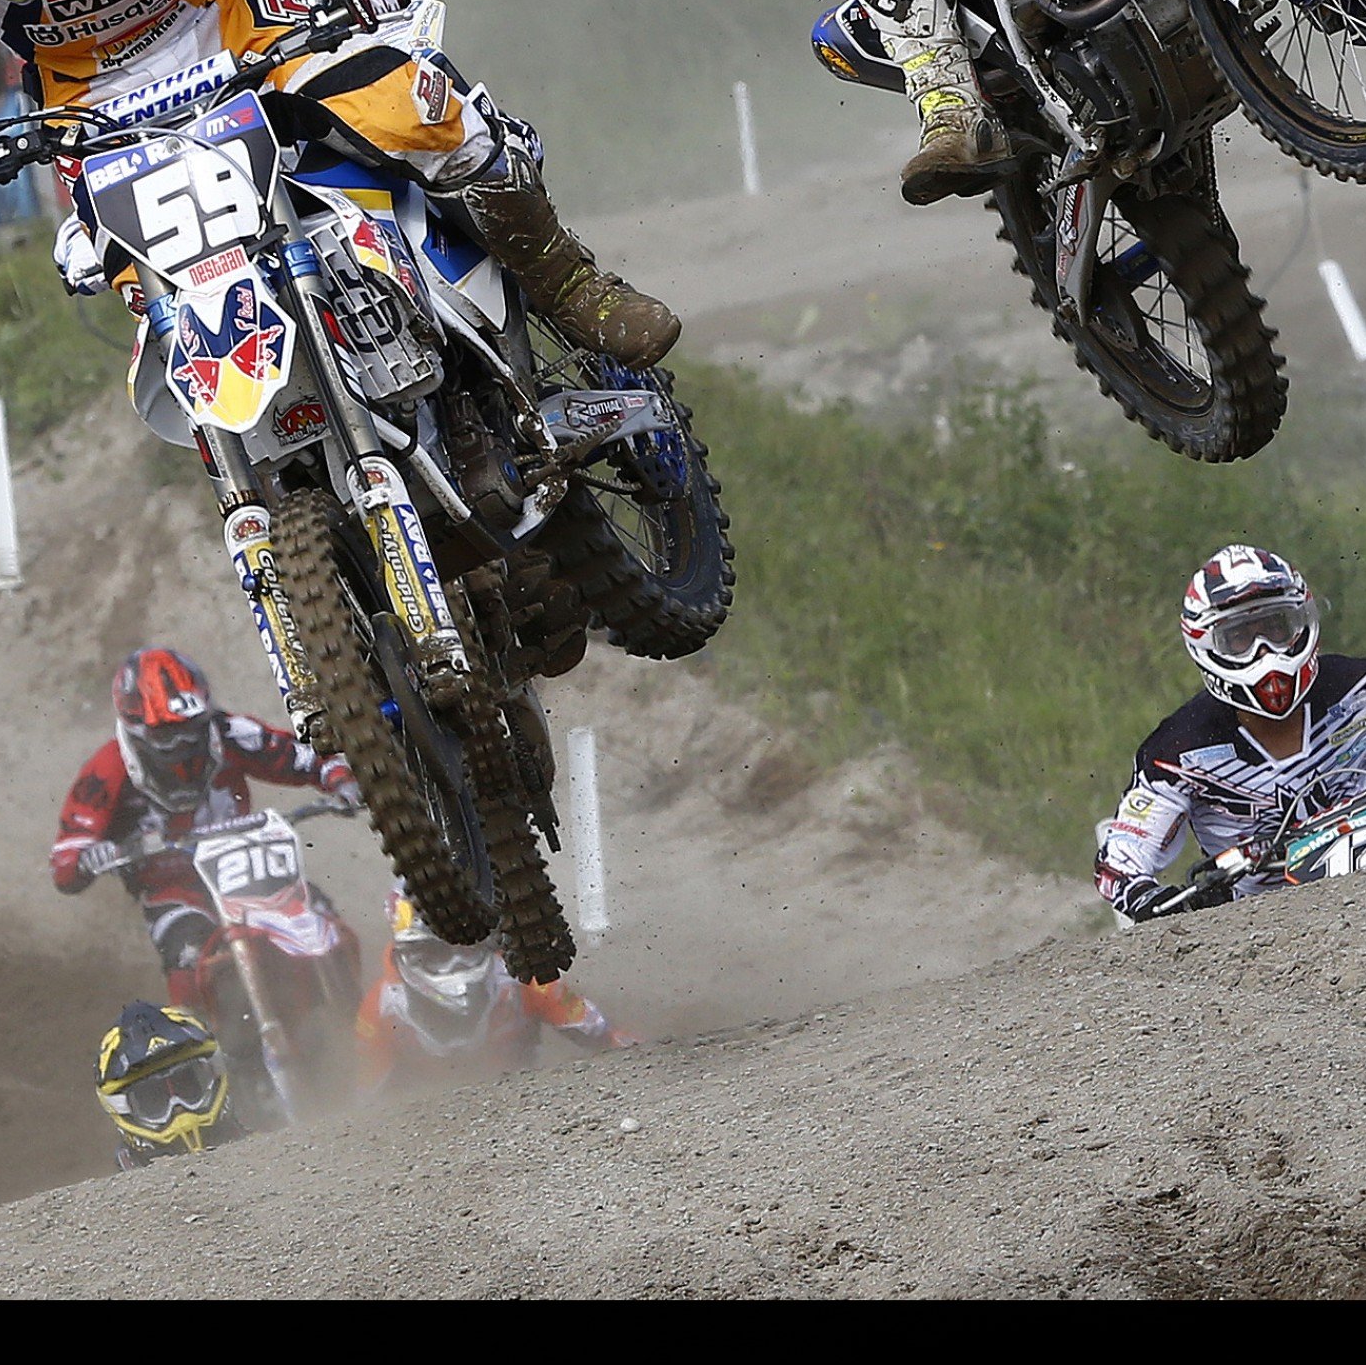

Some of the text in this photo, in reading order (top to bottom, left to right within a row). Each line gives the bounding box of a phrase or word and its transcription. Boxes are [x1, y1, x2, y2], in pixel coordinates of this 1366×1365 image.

[87, 154, 138, 192] BEL
[132, 138, 262, 272] 59
[189, 247, 247, 287] nestaan
